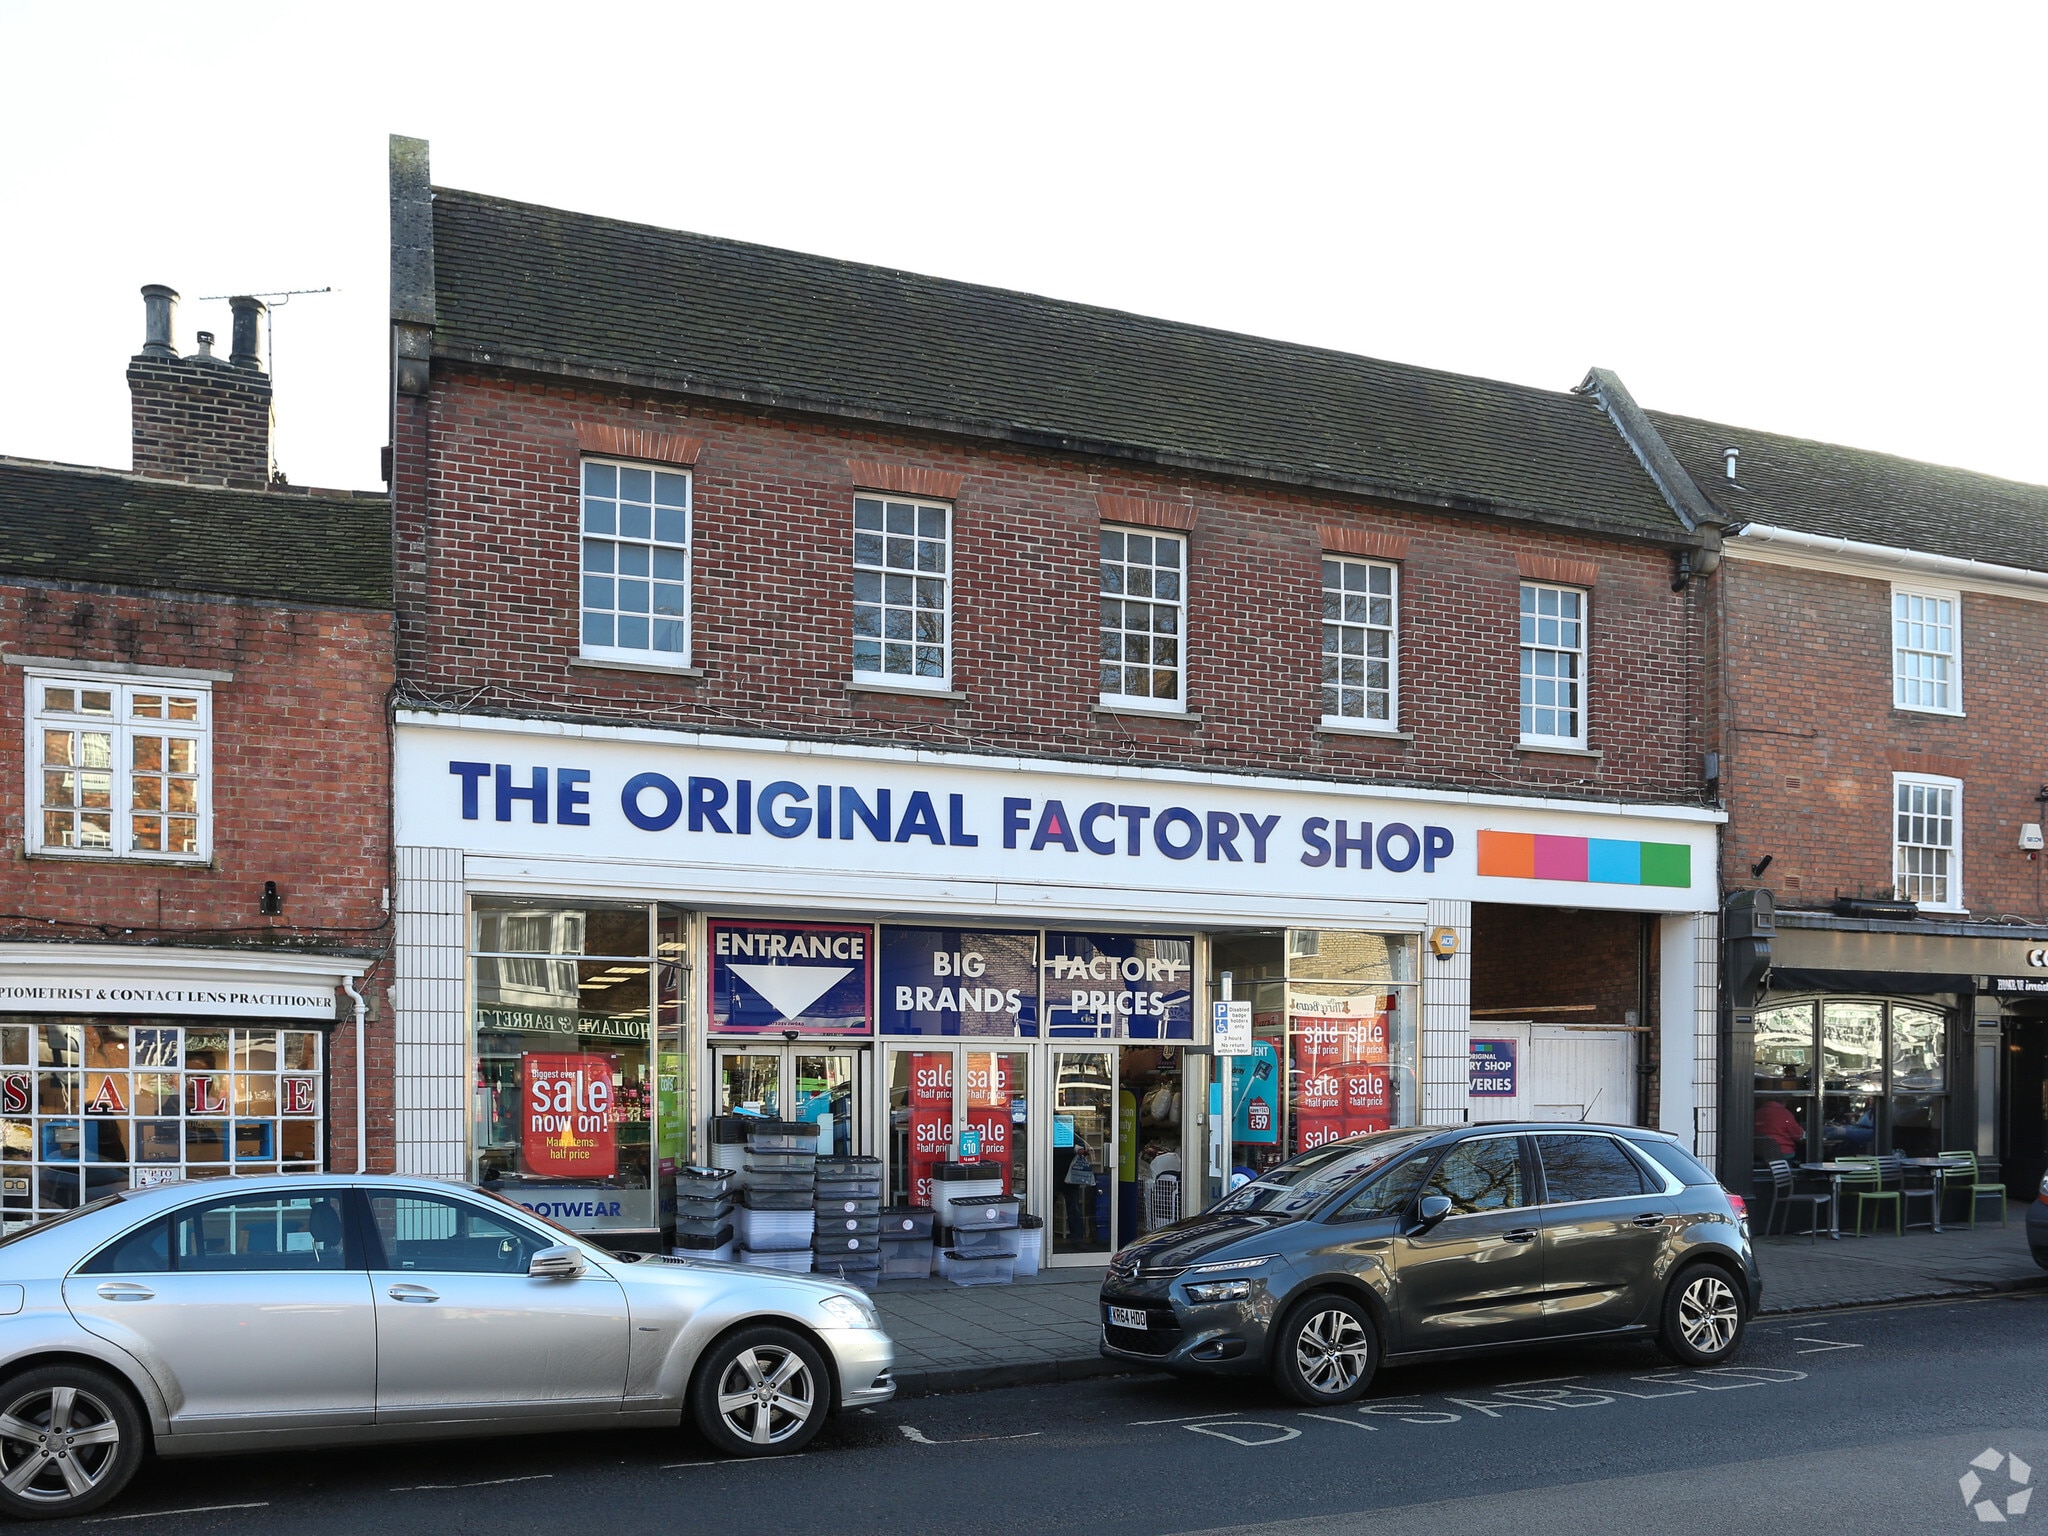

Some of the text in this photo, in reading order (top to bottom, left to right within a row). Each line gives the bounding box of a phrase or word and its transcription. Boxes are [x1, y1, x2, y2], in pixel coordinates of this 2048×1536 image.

[449, 761, 1454, 873] THE ORIGINAL FACTORY SHOP
[716, 932, 864, 960] ENTRANCE
[933, 952, 986, 978] BIG
[1054, 955, 1181, 982] FACTORY
[96, 989, 107, 1000] &
[110, 989, 185, 1002] CONTACT
[188, 991, 226, 1003] LENS
[230, 993, 332, 1008] PRACTITIONER
[895, 986, 1022, 1013] BRANDS
[1071, 990, 1164, 1016] PRICES
[1217, 1005, 1226, 1016] P
[1304, 1021, 1338, 1044] sale
[1349, 1021, 1383, 1043] sale
[1322, 1045, 1338, 1056] price
[532, 1070, 559, 1080] Biggest
[917, 1064, 952, 1087] sale
[1484, 1061, 1512, 1071] SHOP
[532, 1070, 607, 1112] sale
[921, 1089, 935, 1098] half
[1305, 1074, 1338, 1096] sale
[1349, 1073, 1383, 1095] sale
[1469, 1078, 1512, 1091] VERIES
[4, 1074, 314, 1114] SALE
[987, 1090, 1005, 1100] pce
[1308, 1097, 1338, 1109] half price
[1352, 1097, 1383, 1108] half price
[532, 1112, 608, 1132] now on!
[917, 1118, 952, 1141] sale
[1251, 1115, 1268, 1128] £59
[547, 1137, 594, 1150] Many items
[920, 1143, 947, 1154] half pri
[963, 1142, 976, 1154] £10
[986, 1143, 1004, 1154] price
[550, 1149, 589, 1162] half price
[1112, 1307, 1130, 1323] KR64
[1182, 1366, 1808, 1446] DISABLED
